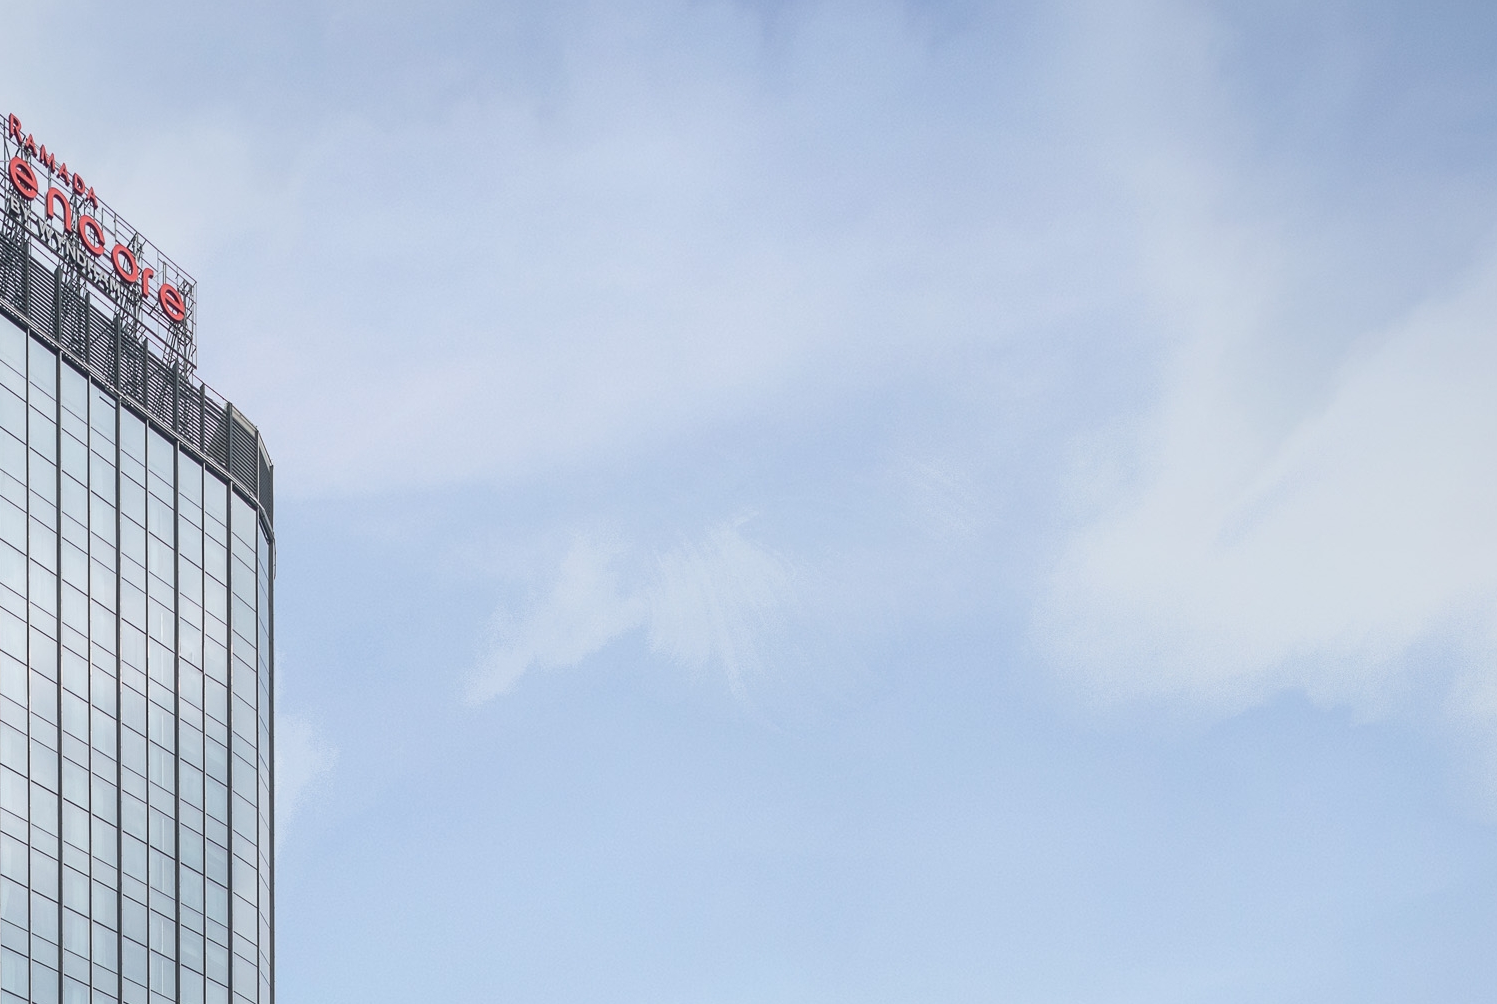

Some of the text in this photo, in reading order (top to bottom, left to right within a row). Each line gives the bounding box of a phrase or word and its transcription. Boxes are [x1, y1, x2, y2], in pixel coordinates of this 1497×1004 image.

[8, 113, 98, 209] RAMADA
[9, 156, 185, 321] encore
[10, 195, 121, 301] BY WYNDHAM
